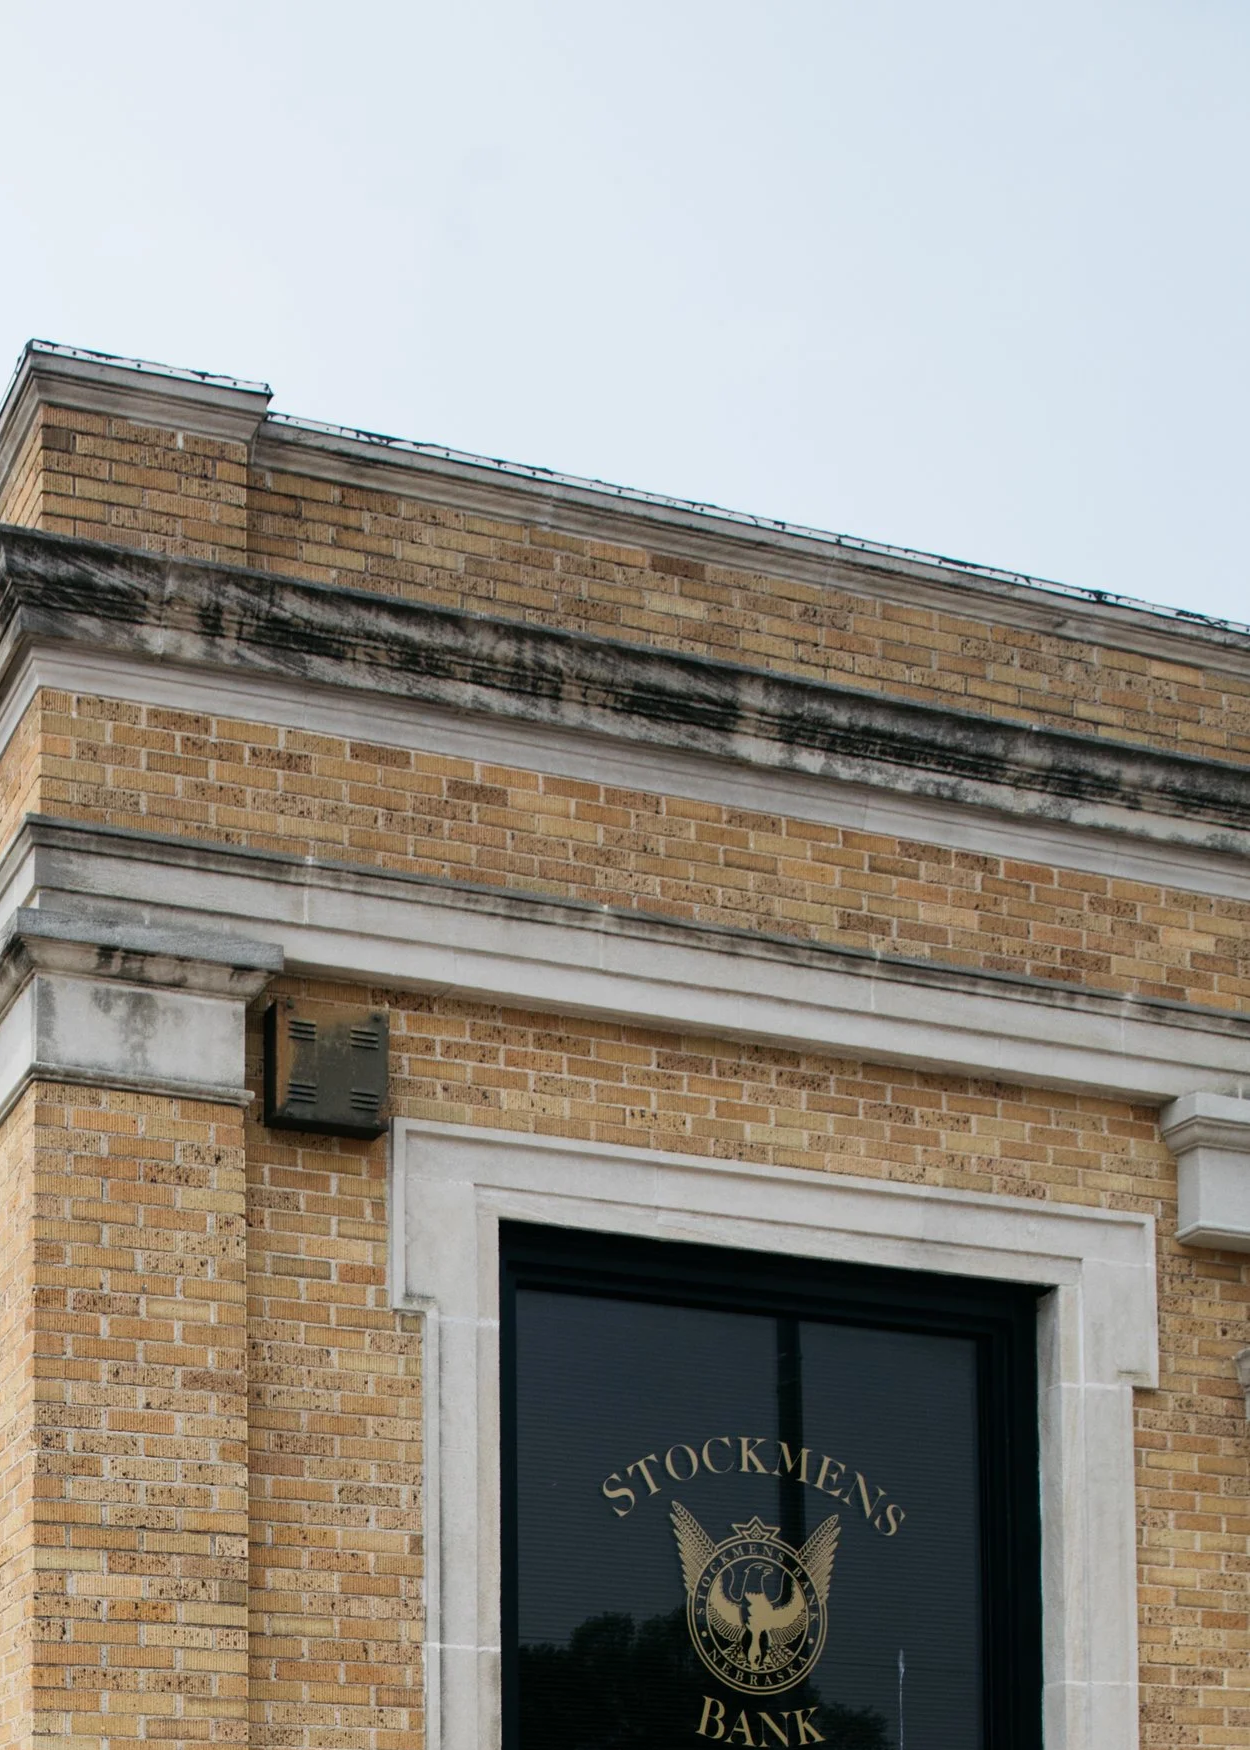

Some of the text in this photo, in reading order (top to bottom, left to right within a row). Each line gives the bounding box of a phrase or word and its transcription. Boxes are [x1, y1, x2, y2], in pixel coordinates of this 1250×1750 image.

[602, 1436, 906, 1537] STOCKMENS
[696, 1544, 819, 1622] STOCKMENS BANK
[707, 1648, 808, 1686] NEBRASKA
[694, 1695, 827, 1748] BANK
